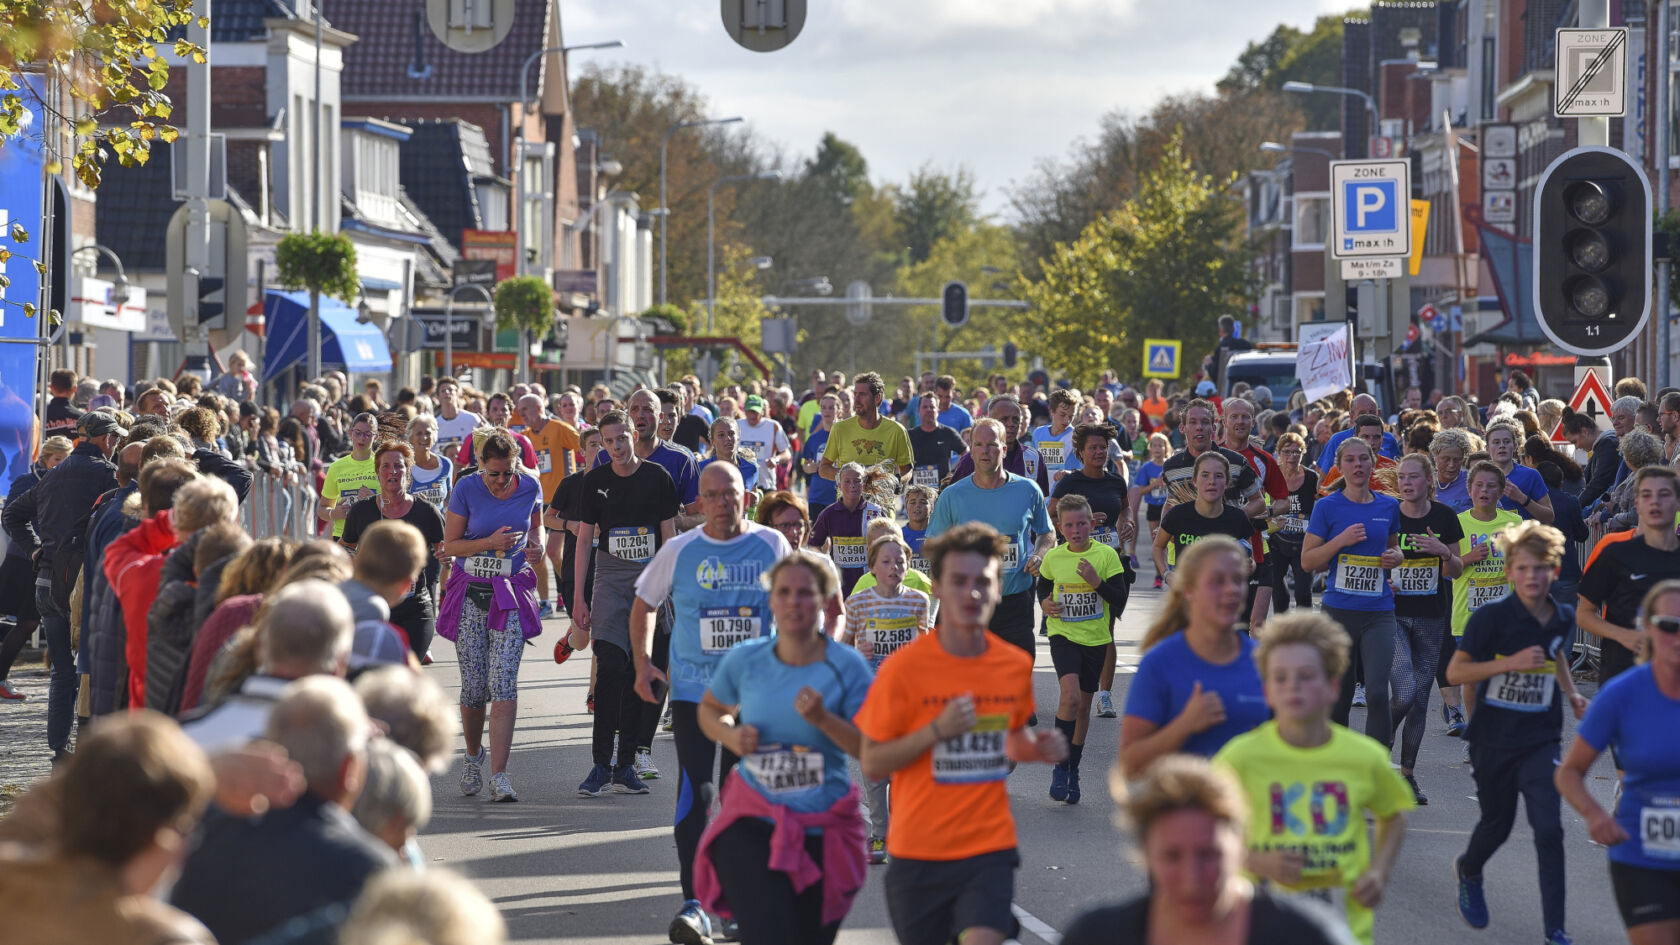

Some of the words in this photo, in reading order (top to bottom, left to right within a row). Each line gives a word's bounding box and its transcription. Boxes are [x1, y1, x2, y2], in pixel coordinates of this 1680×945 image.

[1577, 34, 1607, 43] ZONE
[1353, 167, 1386, 178] ZONE
[1356, 186, 1385, 228] P
[1355, 240, 1379, 248] max
[1350, 261, 1364, 269] Ma
[1365, 260, 1381, 268] t/m
[1383, 260, 1394, 268] Za
[1585, 325, 1600, 336] 1.1
[338, 475, 377, 484] GROOTEGAS
[1289, 503, 1302, 511] RE
[616, 536, 649, 548] 10.204
[616, 548, 649, 559] KYLIAN
[837, 545, 864, 554] 12.590
[474, 557, 502, 569] 9.828
[838, 555, 866, 563] SARAH
[1471, 559, 1505, 567] MERLIN
[1344, 565, 1379, 579] 12.200
[1399, 567, 1433, 579] 12.923
[1344, 577, 1377, 592] MEIKE
[1402, 579, 1430, 590] ELISE
[1475, 586, 1504, 598] 12.722
[1063, 592, 1098, 606] 12.359
[1065, 604, 1097, 617] TWAN
[710, 618, 752, 633] 10.790
[873, 629, 912, 643] 12.583
[1504, 672, 1546, 688] 12.341
[1498, 686, 1544, 704] EDWIN
[1647, 815, 1680, 841] CO
